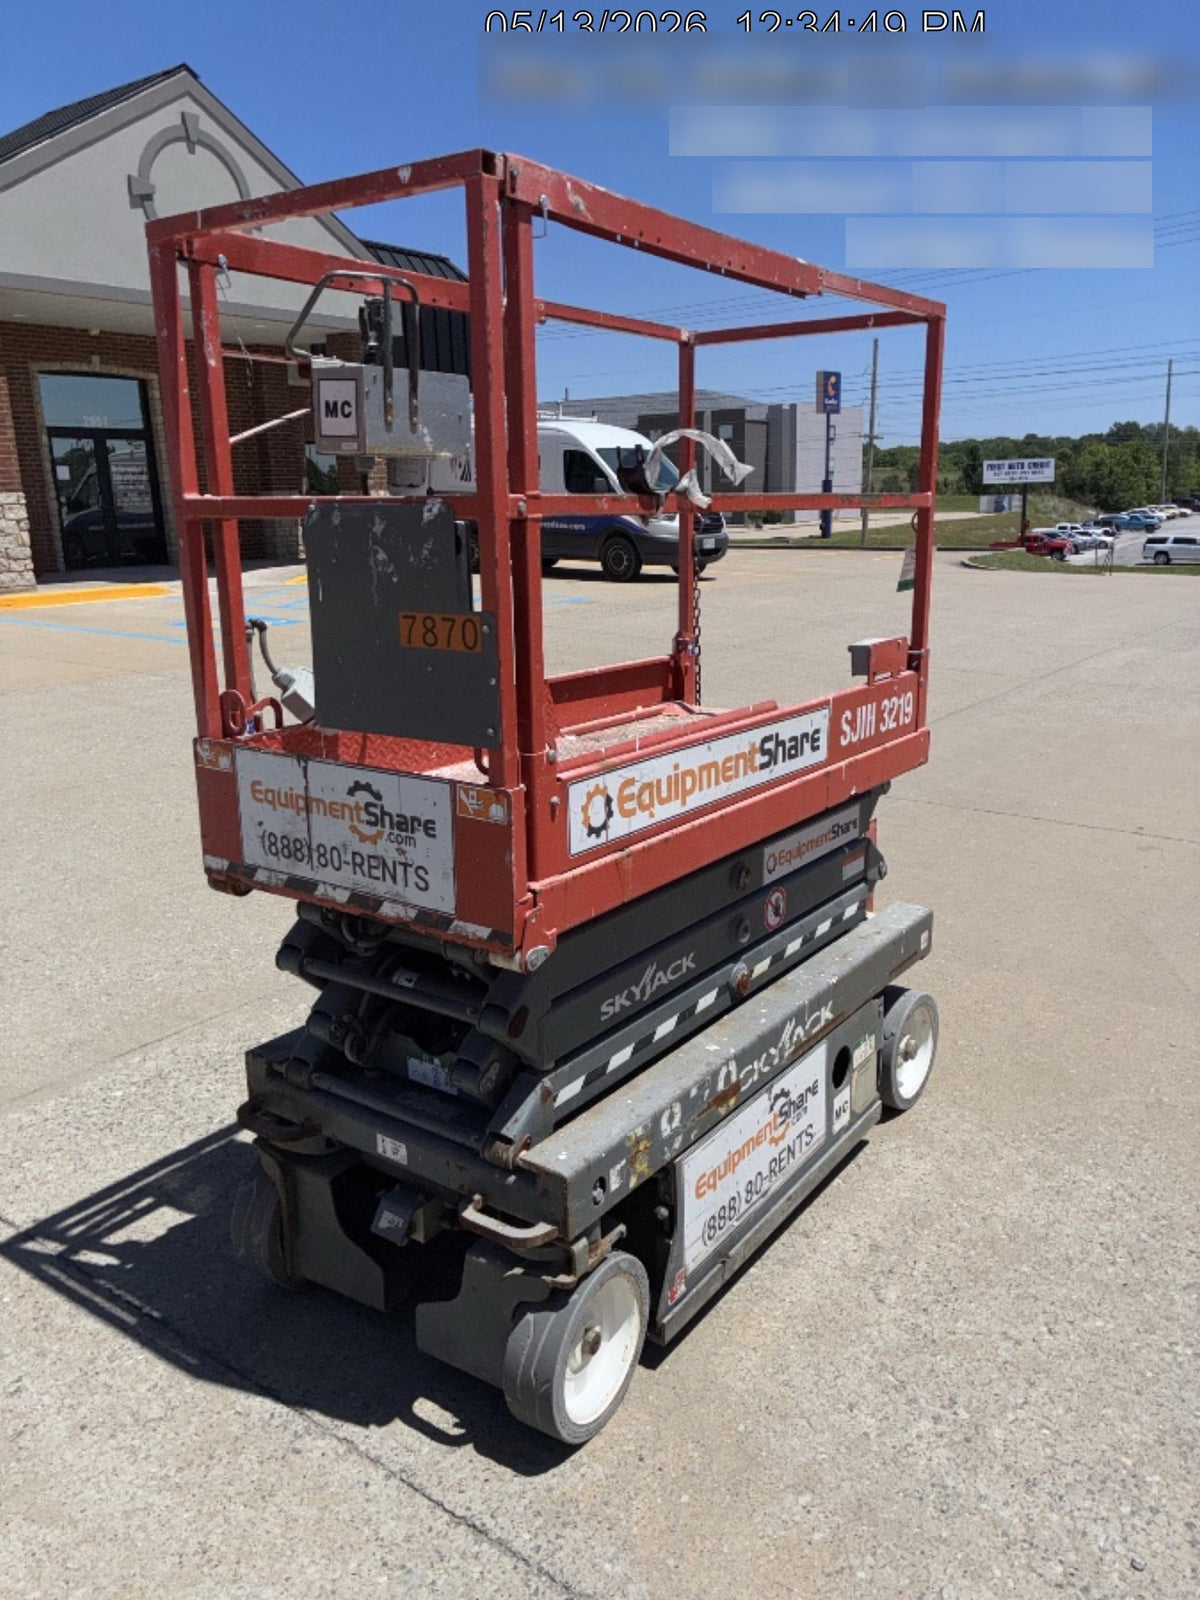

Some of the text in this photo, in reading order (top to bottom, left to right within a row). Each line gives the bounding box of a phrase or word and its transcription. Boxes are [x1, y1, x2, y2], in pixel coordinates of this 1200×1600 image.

[324, 399, 353, 419] MC
[402, 614, 479, 650] 7870
[880, 691, 913, 733] 3219
[617, 727, 821, 820] EquipmentShare
[250, 780, 437, 839] EquipmentShare
[385, 829, 417, 848] .com
[778, 817, 858, 866] EquipmentShare
[599, 952, 696, 1022] SKYJACK
[834, 1099, 849, 1120] MC
[694, 1079, 819, 1199] EquipmentShare
[744, 1123, 815, 1204] 80-RENTS
